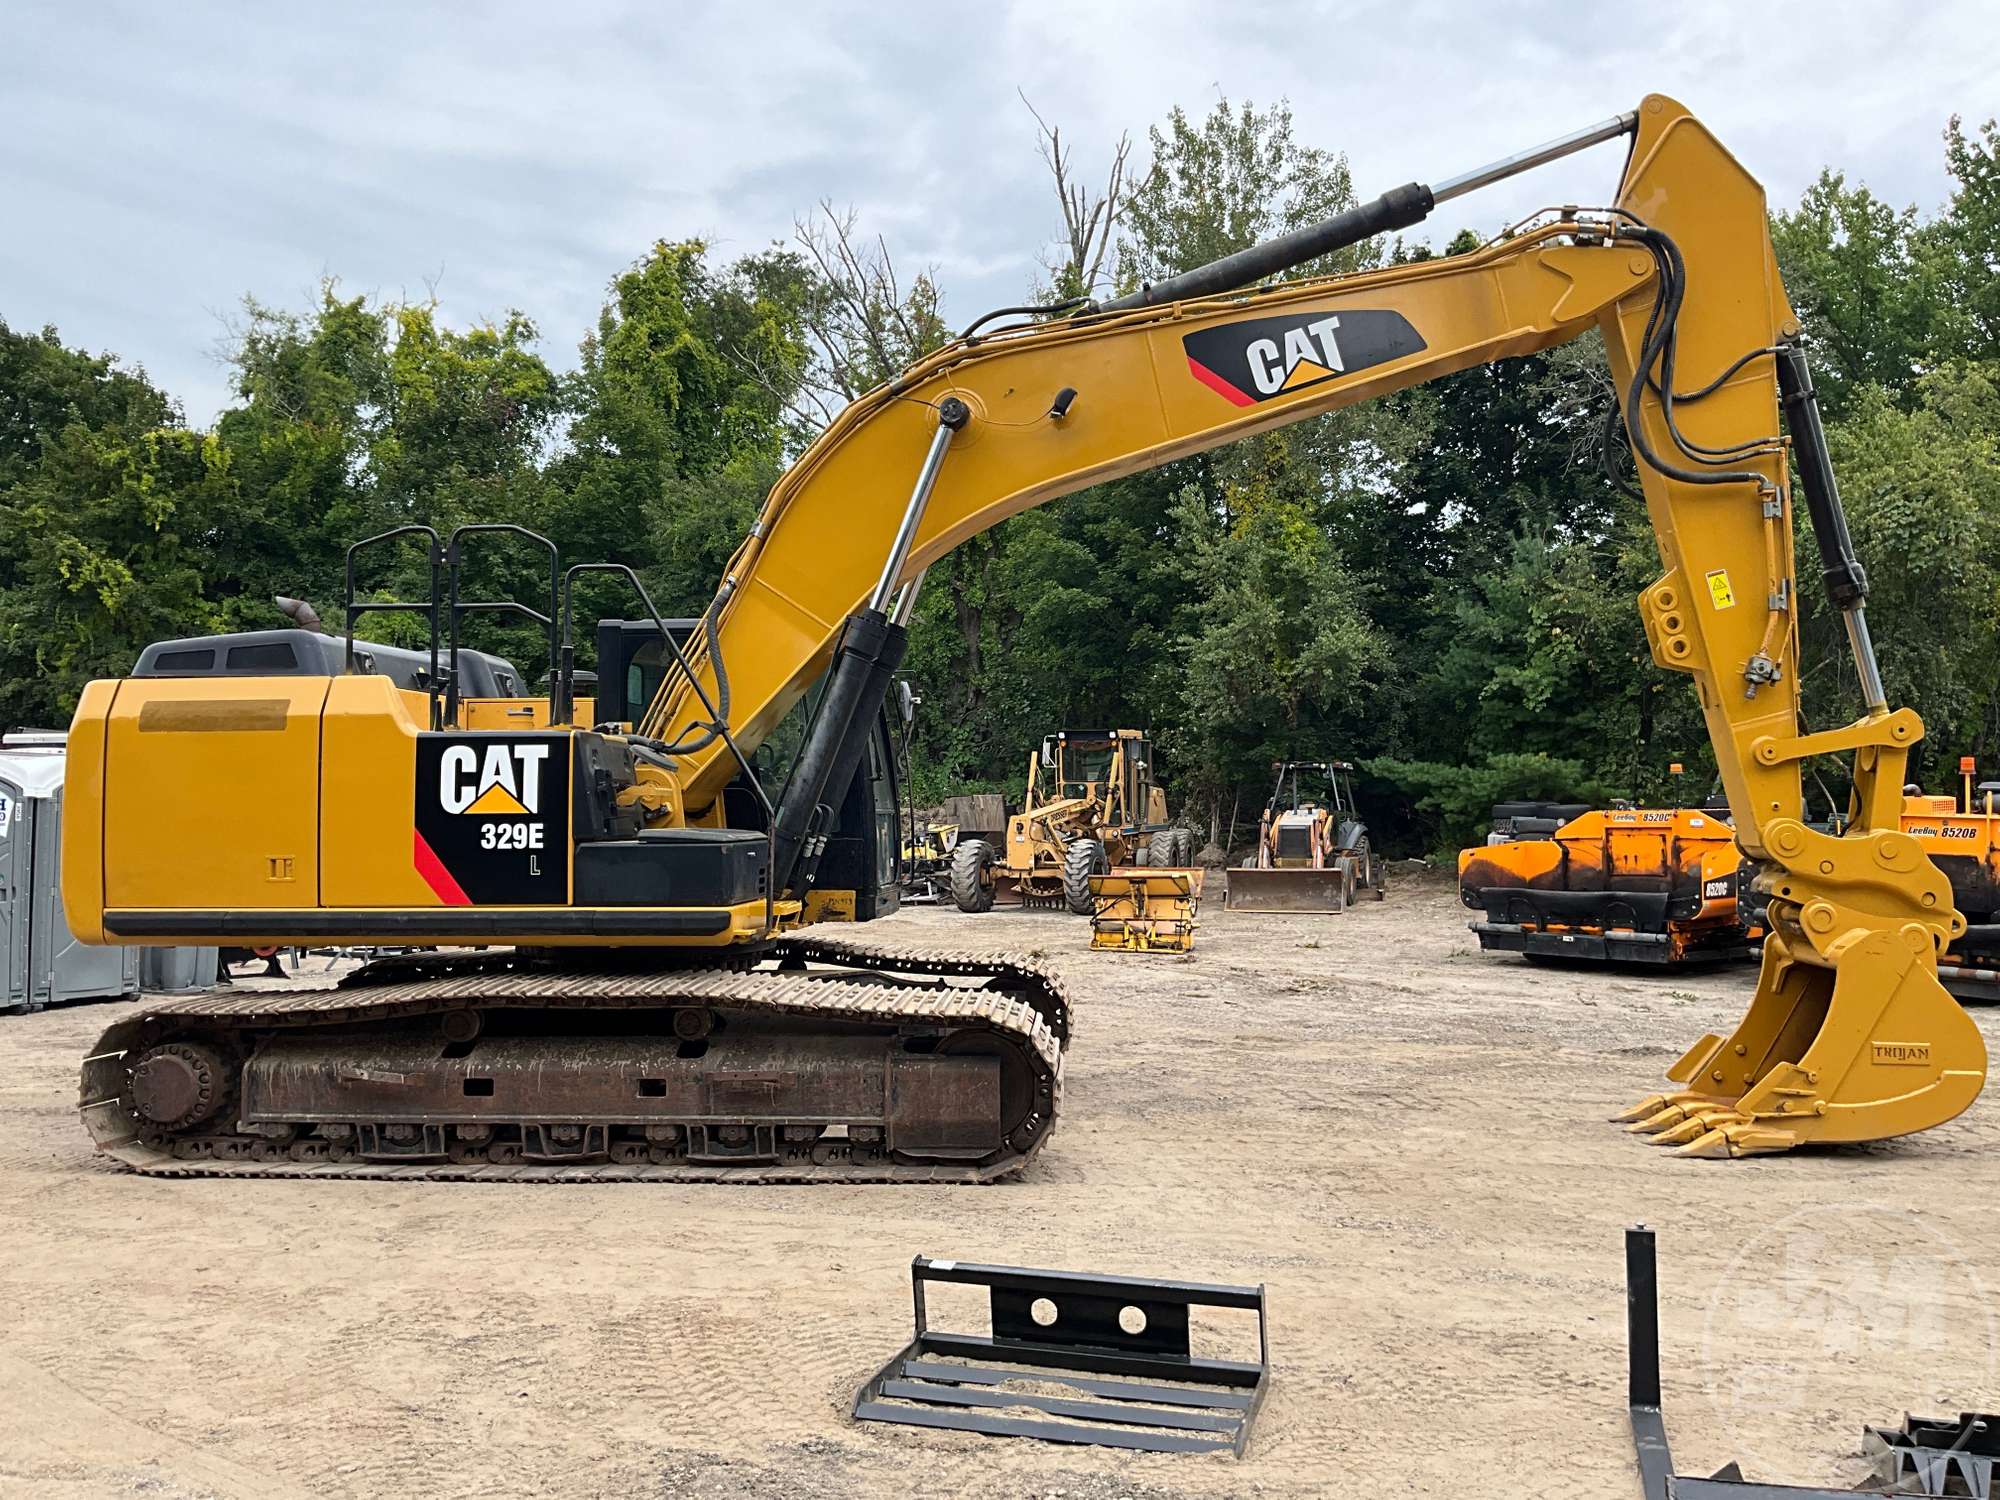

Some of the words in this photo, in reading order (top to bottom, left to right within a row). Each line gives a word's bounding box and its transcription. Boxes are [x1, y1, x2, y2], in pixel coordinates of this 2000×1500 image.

[1246, 315, 1344, 394] CAT
[440, 744, 549, 814] CAT
[1642, 813, 1671, 822] 8520C
[480, 822, 544, 849] 329E
[1908, 826, 1938, 837] LeeBoy
[1941, 827, 1977, 839] 8520B
[530, 854, 541, 876] L
[1706, 881, 1728, 897] 8520C
[1873, 1046, 1929, 1061] TROJAN
